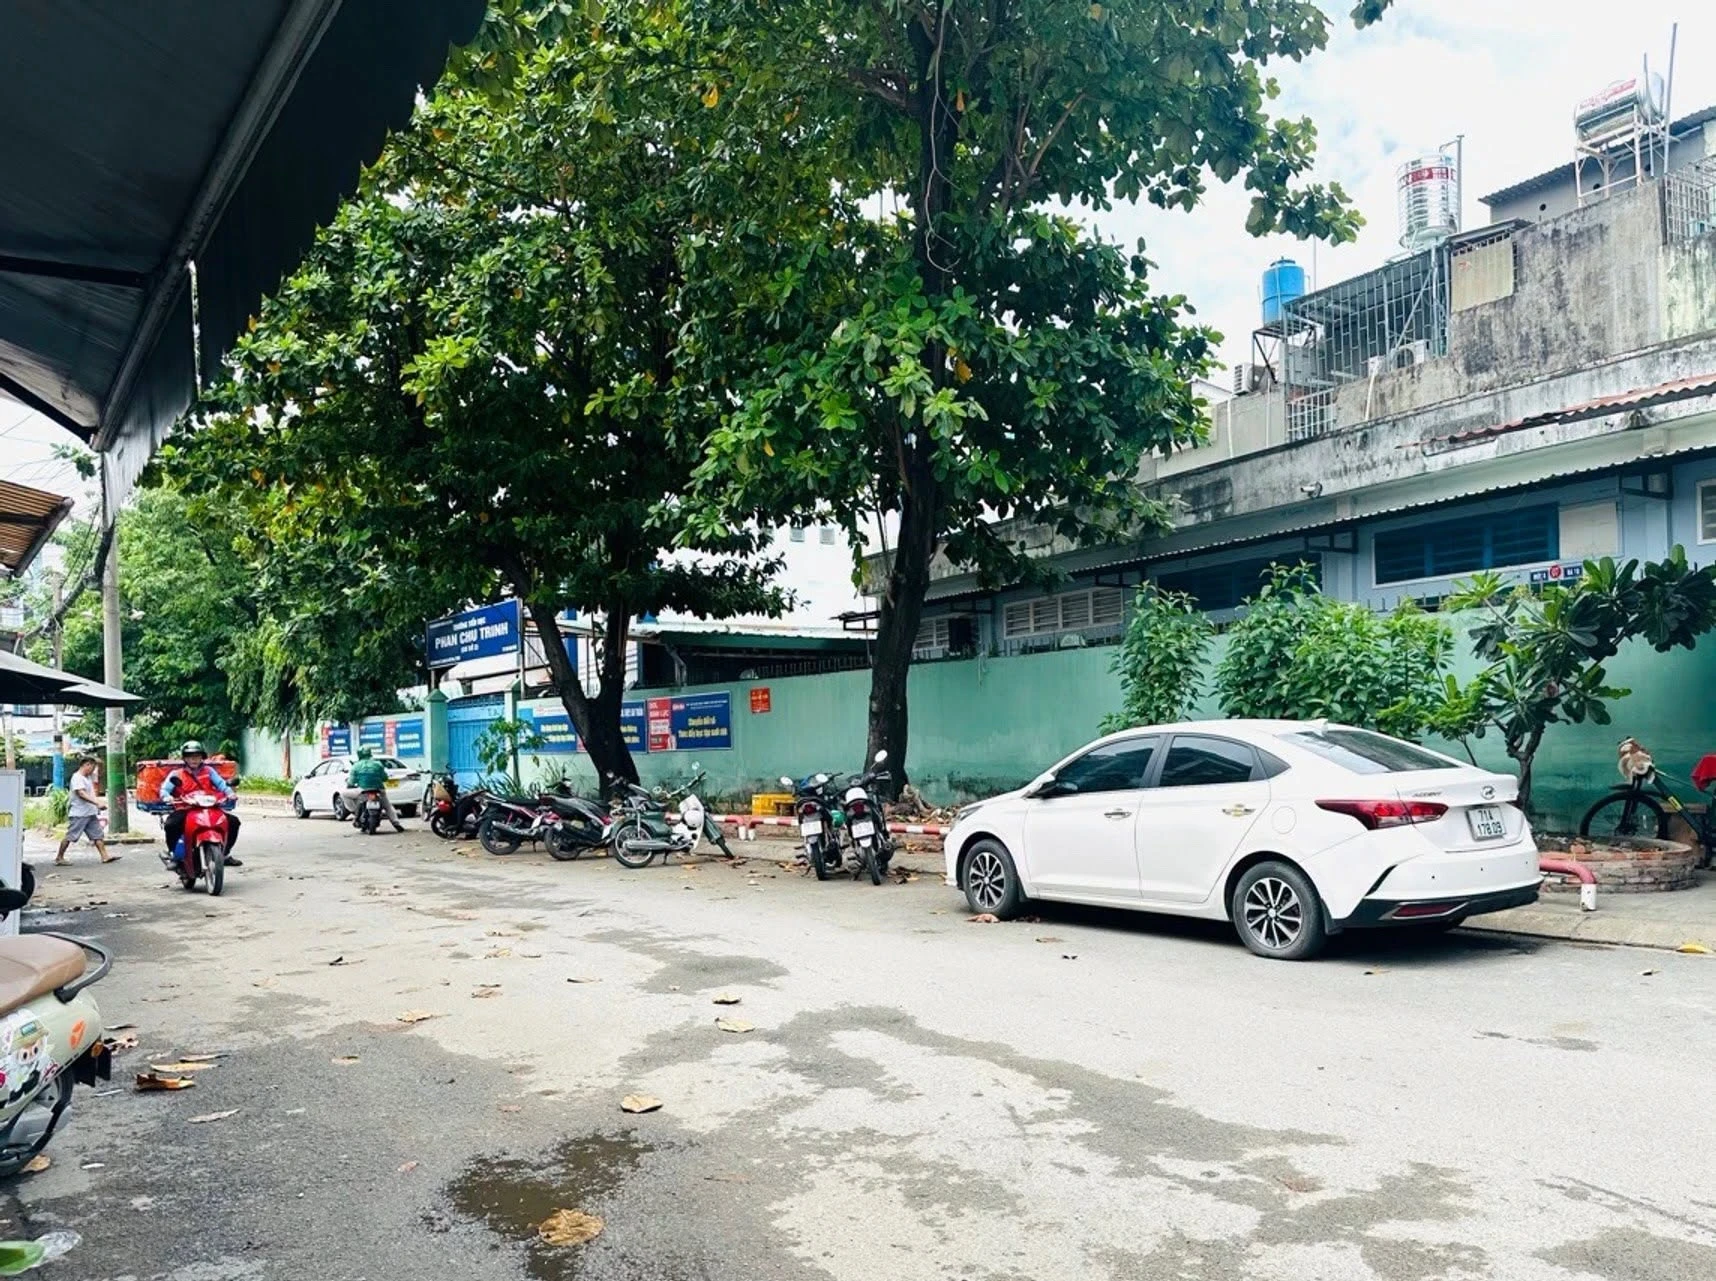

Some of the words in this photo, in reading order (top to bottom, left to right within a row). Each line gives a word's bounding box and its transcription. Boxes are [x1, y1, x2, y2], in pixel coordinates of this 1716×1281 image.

[435, 634, 458, 650] PHAN
[459, 628, 478, 645] CHU
[479, 621, 509, 640] TRINH
